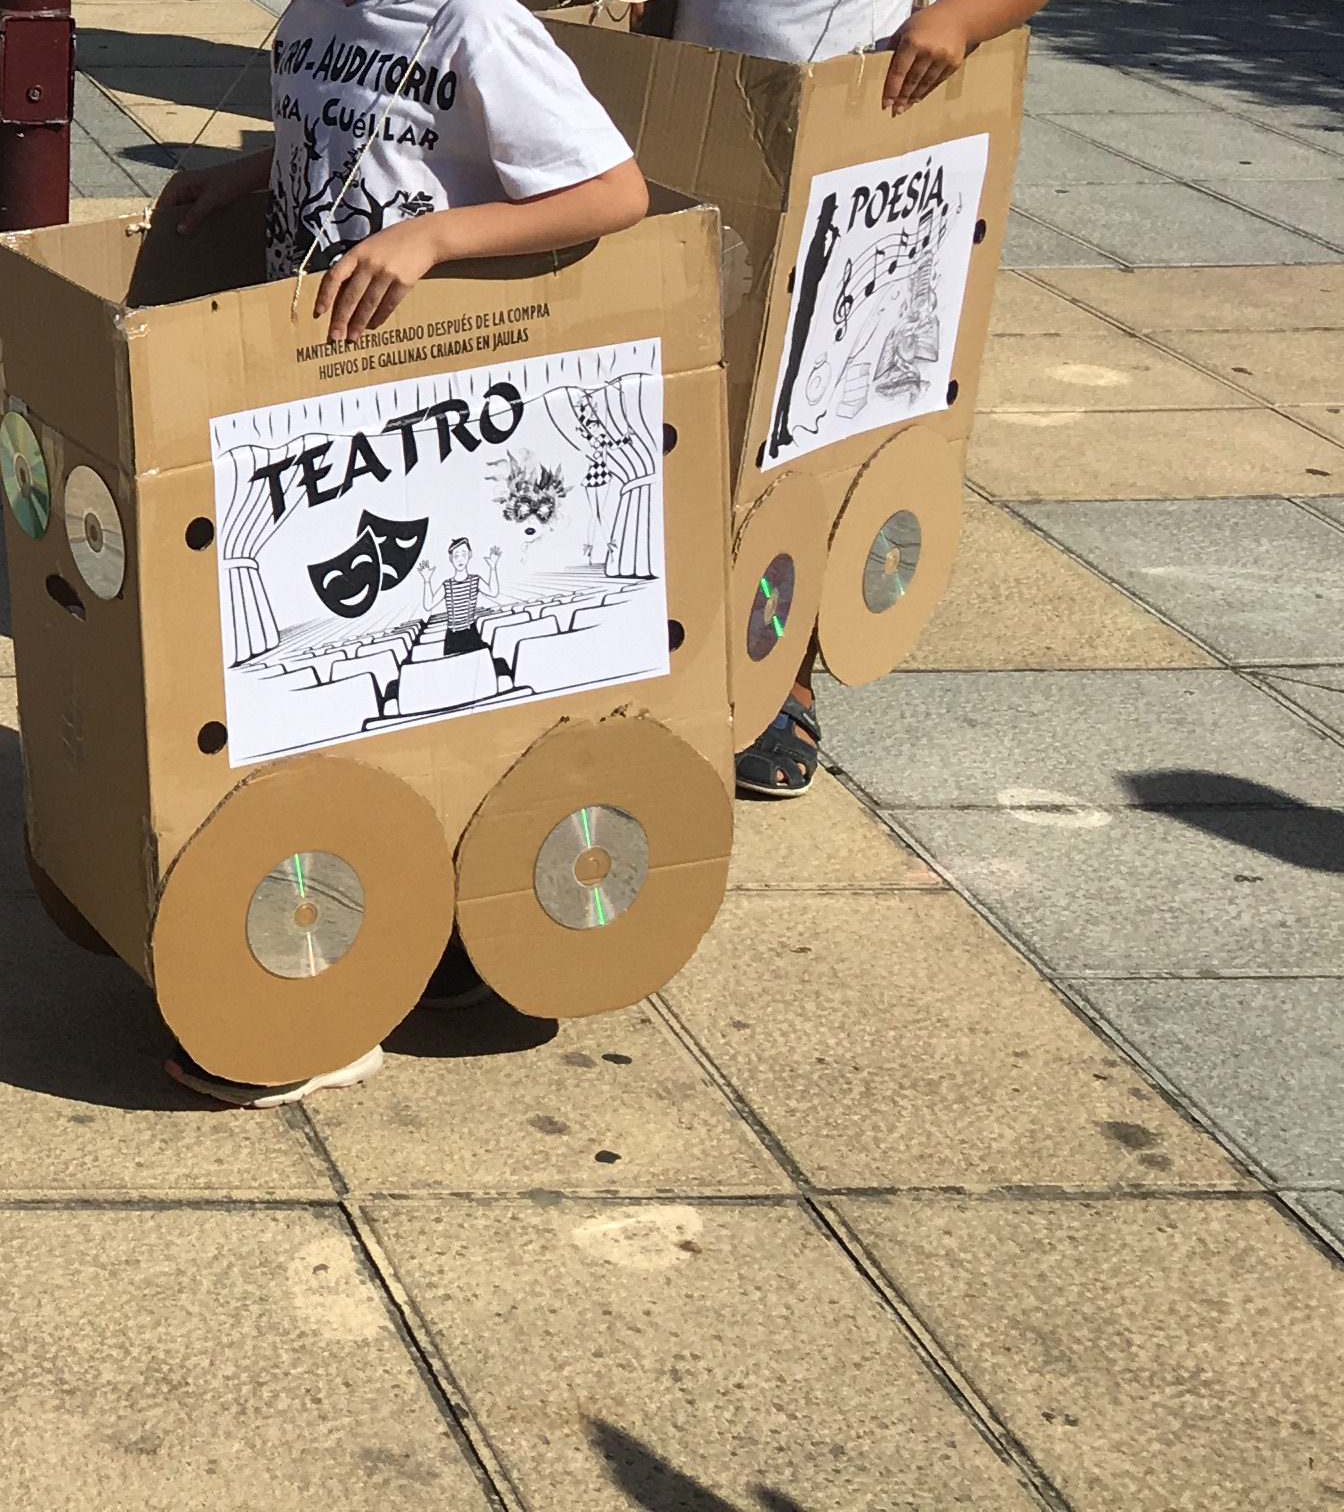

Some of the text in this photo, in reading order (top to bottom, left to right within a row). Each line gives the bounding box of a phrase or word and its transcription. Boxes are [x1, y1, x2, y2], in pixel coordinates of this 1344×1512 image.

[846, 155, 945, 235] POESÍA
[296, 302, 551, 364] MANTENER REFRIGERADO DESPUÉS DE LA COMPRA
[318, 327, 530, 380] HUEVOS DE GALLINAS CRIADAS EN JAULAS
[248, 382, 525, 525] TEATRO
